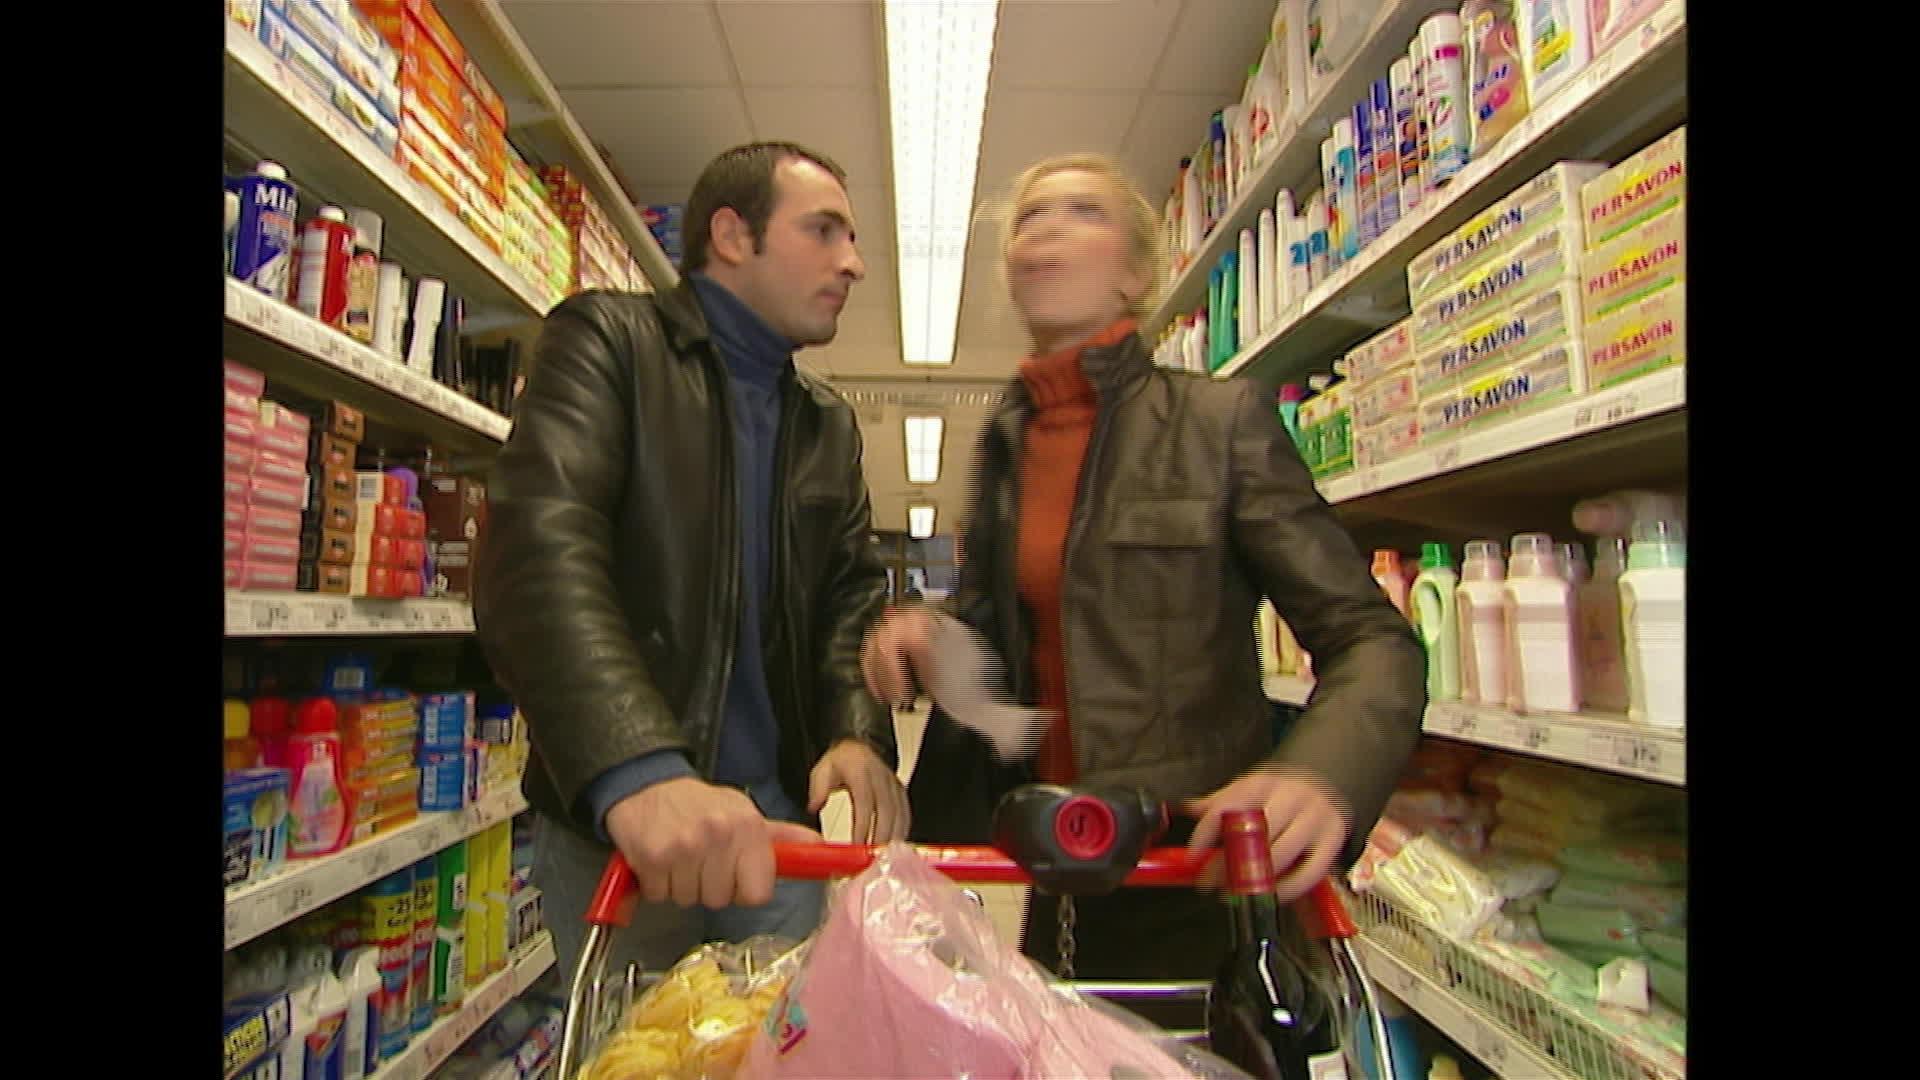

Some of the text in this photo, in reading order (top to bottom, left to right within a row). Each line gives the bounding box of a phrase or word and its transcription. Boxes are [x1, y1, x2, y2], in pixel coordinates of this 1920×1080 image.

[1591, 161, 1682, 223] PERSAVON
[1435, 206, 1522, 267] PERSAVON
[1439, 260, 1524, 320] PERSAVON
[1588, 240, 1679, 294] PERSAVON
[1441, 317, 1526, 373] PERSAVON
[1591, 320, 1673, 365] PERSAVON
[1444, 374, 1530, 425] PERSAVON
